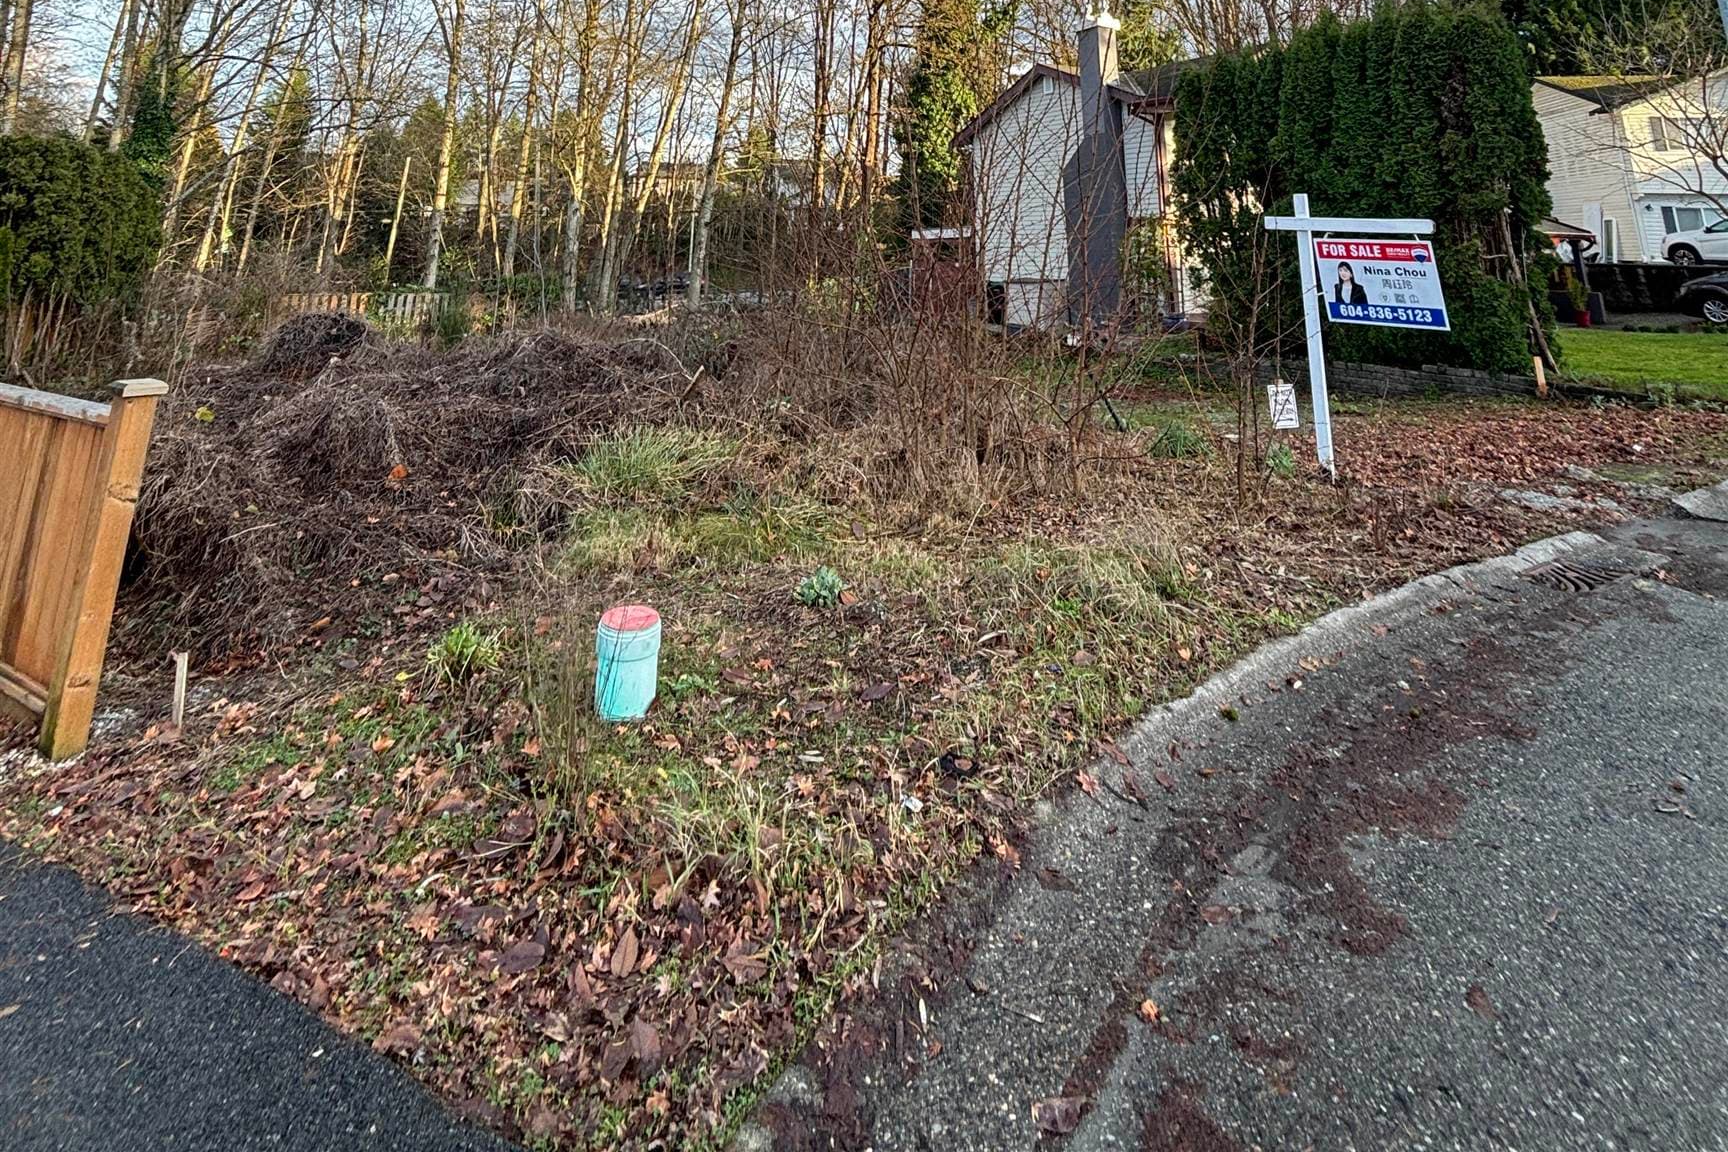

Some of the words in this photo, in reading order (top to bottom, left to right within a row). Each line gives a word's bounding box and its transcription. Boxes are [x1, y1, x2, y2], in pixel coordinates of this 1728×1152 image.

[1322, 244, 1346, 256] FOR
[1350, 245, 1382, 257] SALE
[1364, 266, 1391, 276] Nina
[1395, 267, 1426, 277] Chou
[1340, 305, 1432, 322] 604-836-5123
